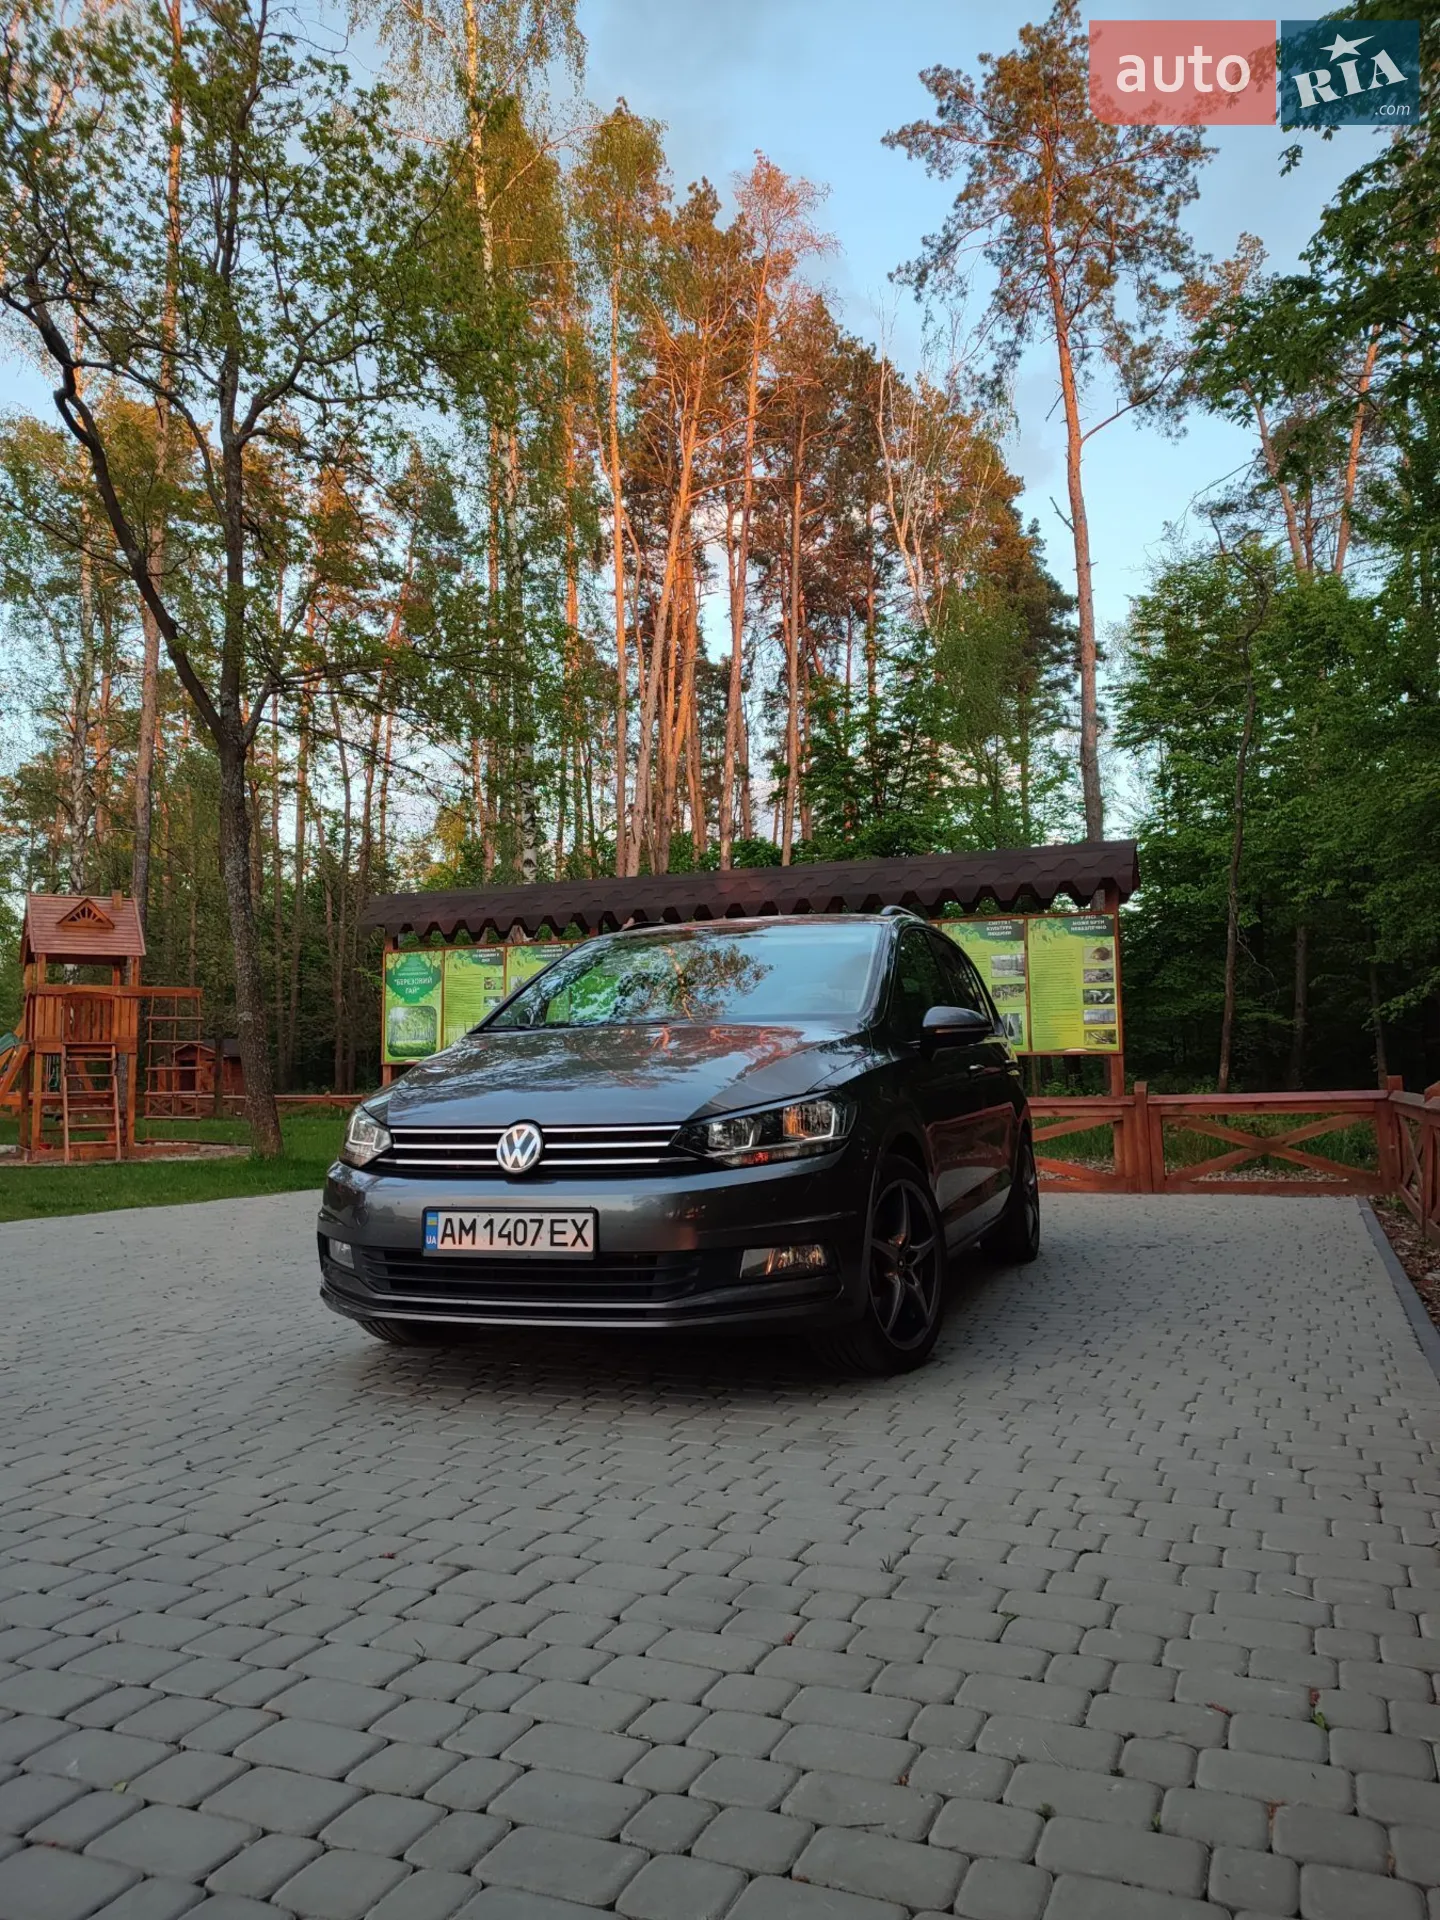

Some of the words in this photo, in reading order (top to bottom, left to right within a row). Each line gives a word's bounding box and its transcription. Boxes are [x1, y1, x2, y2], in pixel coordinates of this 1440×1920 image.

[426, 1236, 437, 1245] UA
[440, 1218, 477, 1246] AM
[483, 1218, 544, 1247] 1407
[550, 1219, 589, 1247] EX
